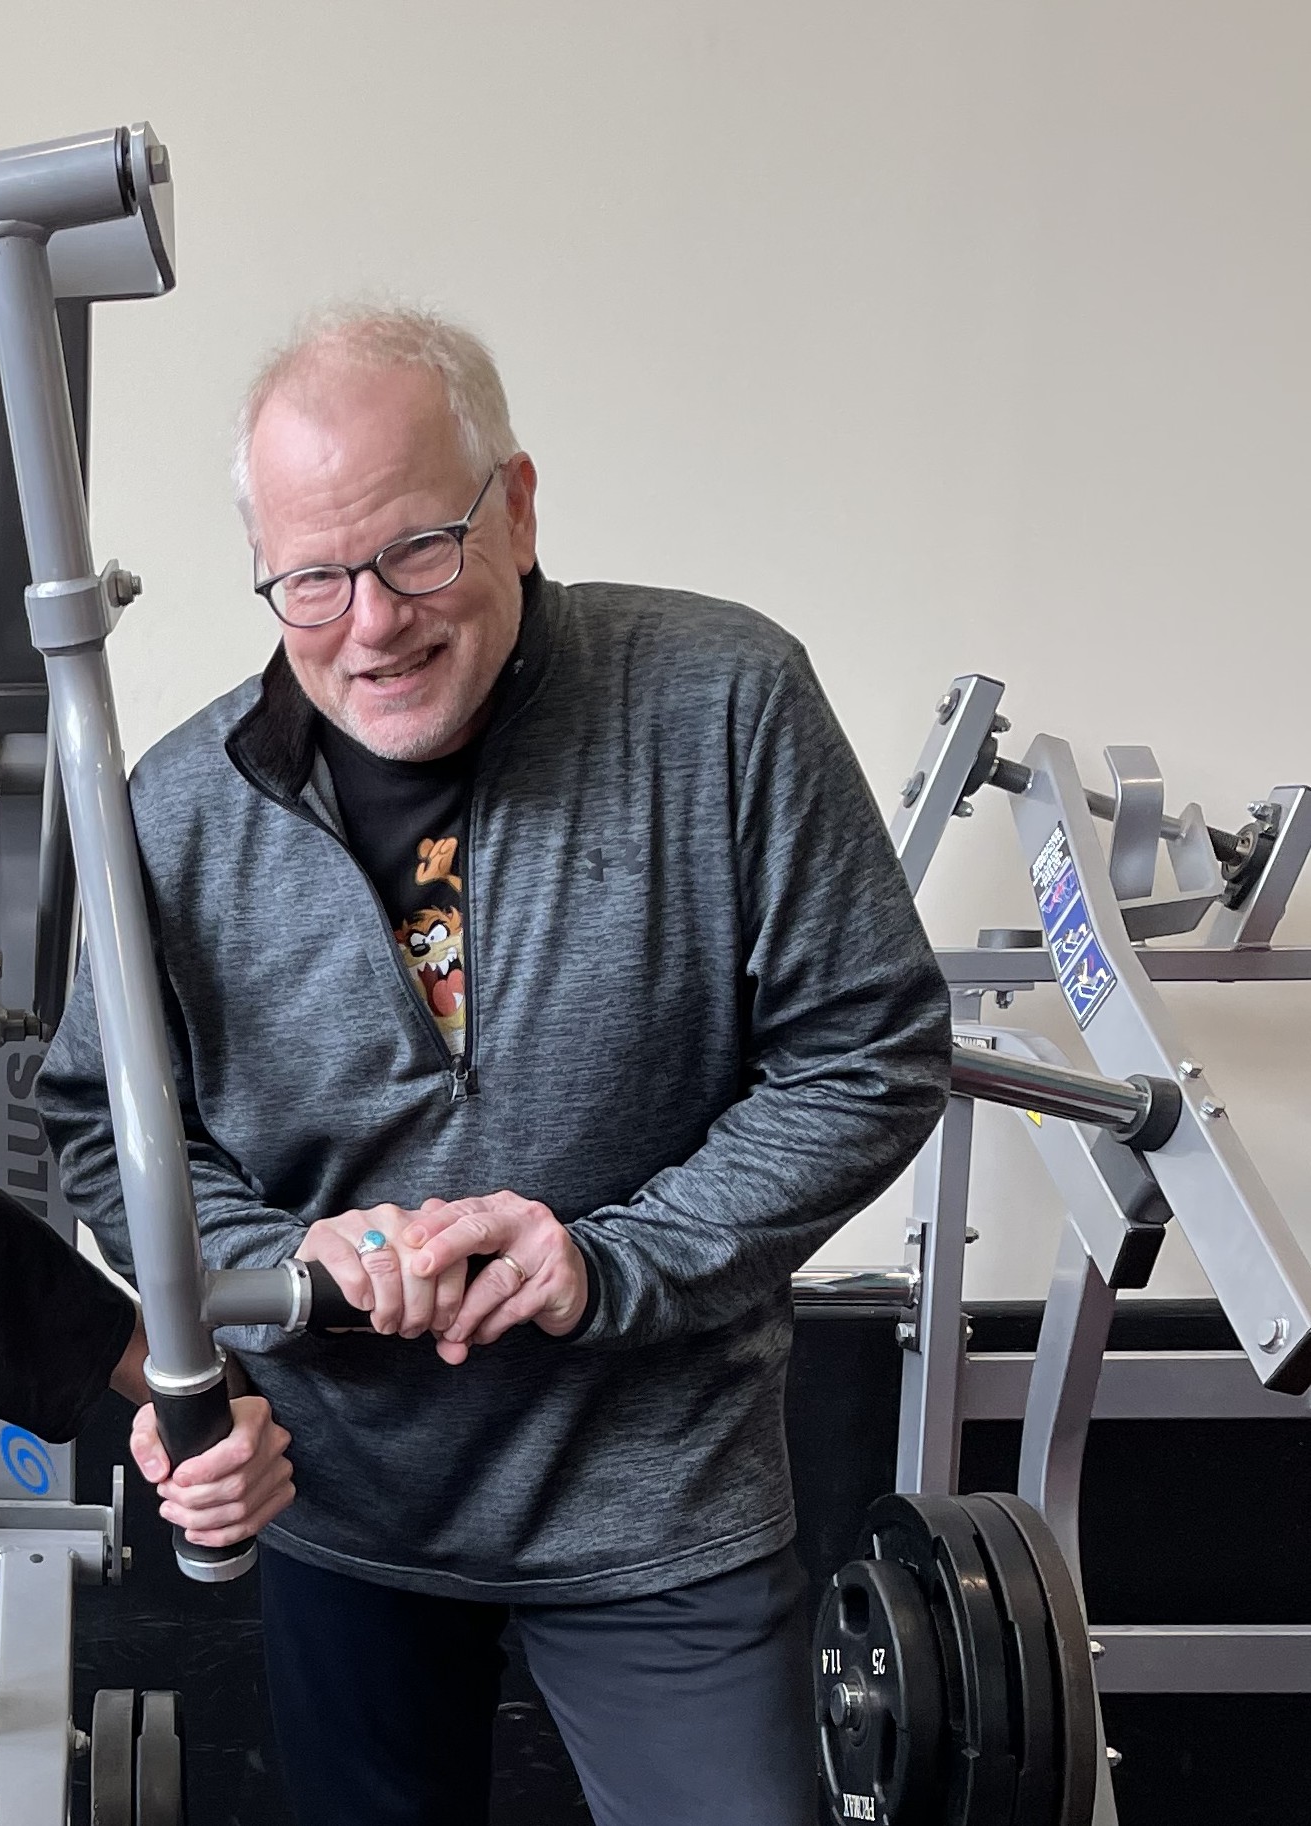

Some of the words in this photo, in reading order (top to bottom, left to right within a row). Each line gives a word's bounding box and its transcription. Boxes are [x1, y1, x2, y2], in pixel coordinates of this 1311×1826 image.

[7, 1053, 48, 1218] ILUS
[822, 1649, 841, 1675] 11.4
[872, 1649, 885, 1675] 25
